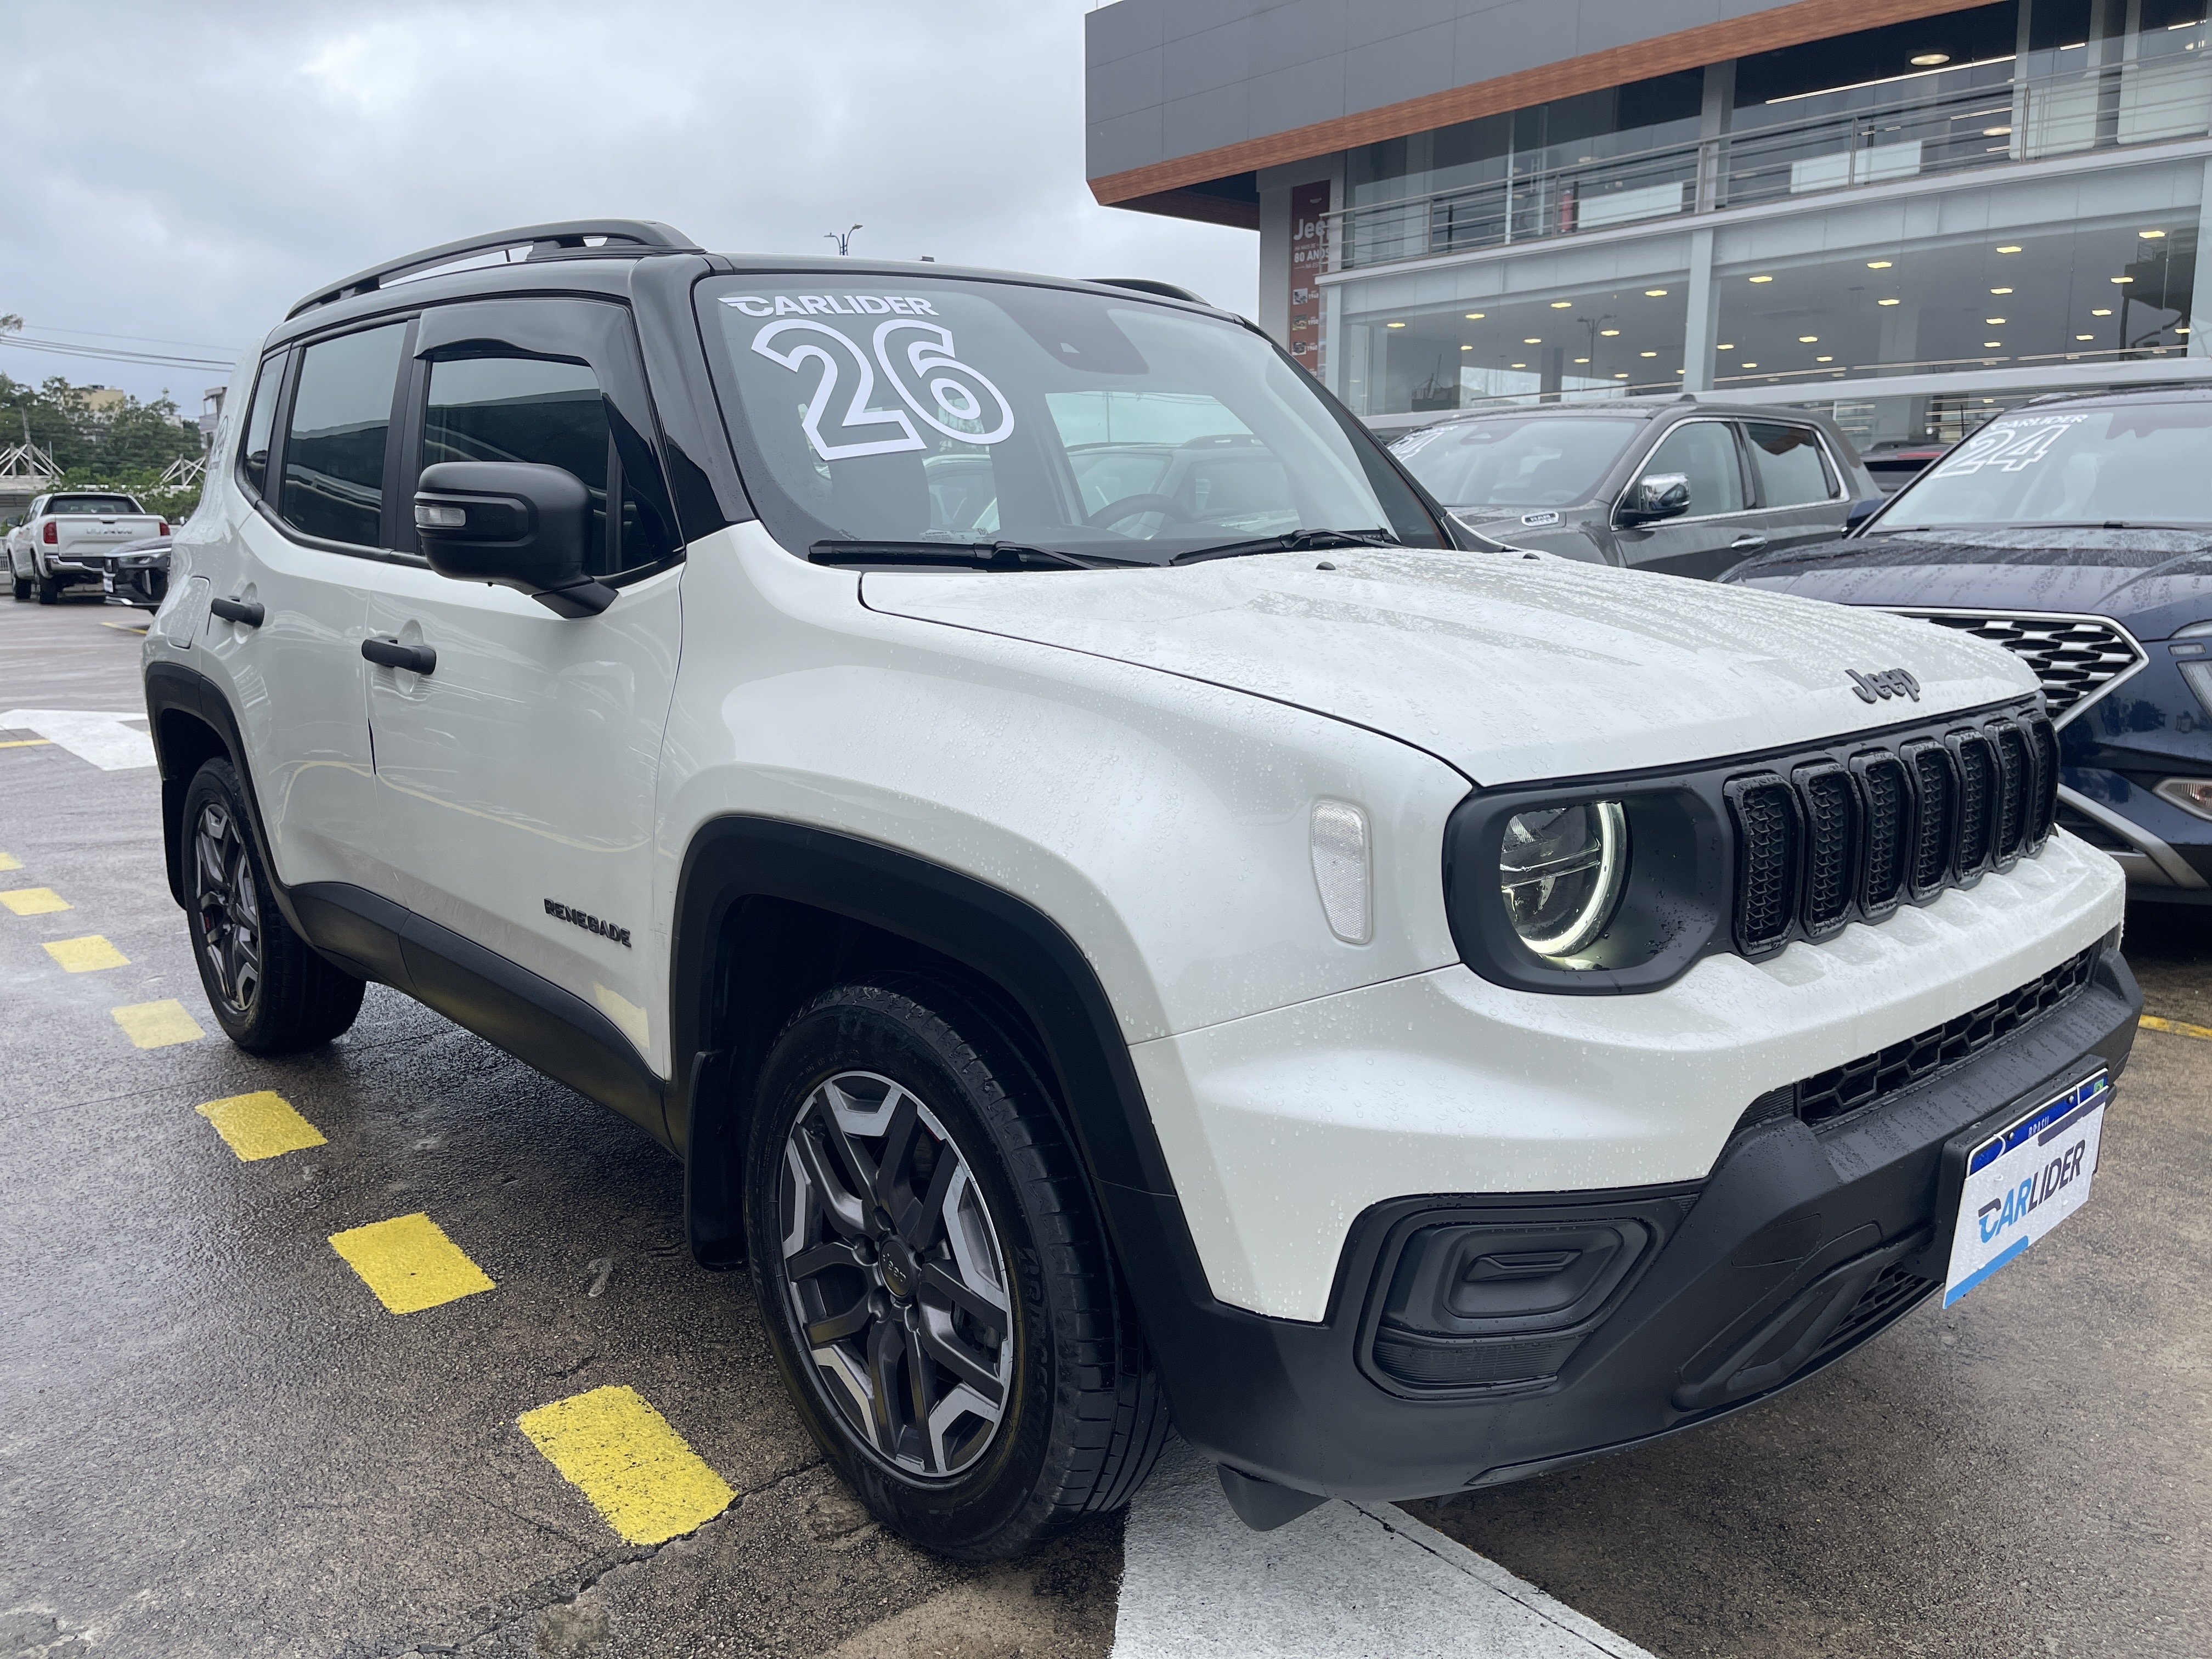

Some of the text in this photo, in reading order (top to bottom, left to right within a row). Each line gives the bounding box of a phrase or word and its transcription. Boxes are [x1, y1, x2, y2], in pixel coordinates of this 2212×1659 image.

[1294, 251, 1305, 263] 80
[717, 296, 940, 317] CARLIDER
[751, 319, 1015, 461] 26
[1931, 424, 2072, 479] 24
[1844, 668, 1920, 704] Jeep
[544, 898, 632, 948] RENEGADE
[1978, 1139, 2085, 1243] CARLIDER
